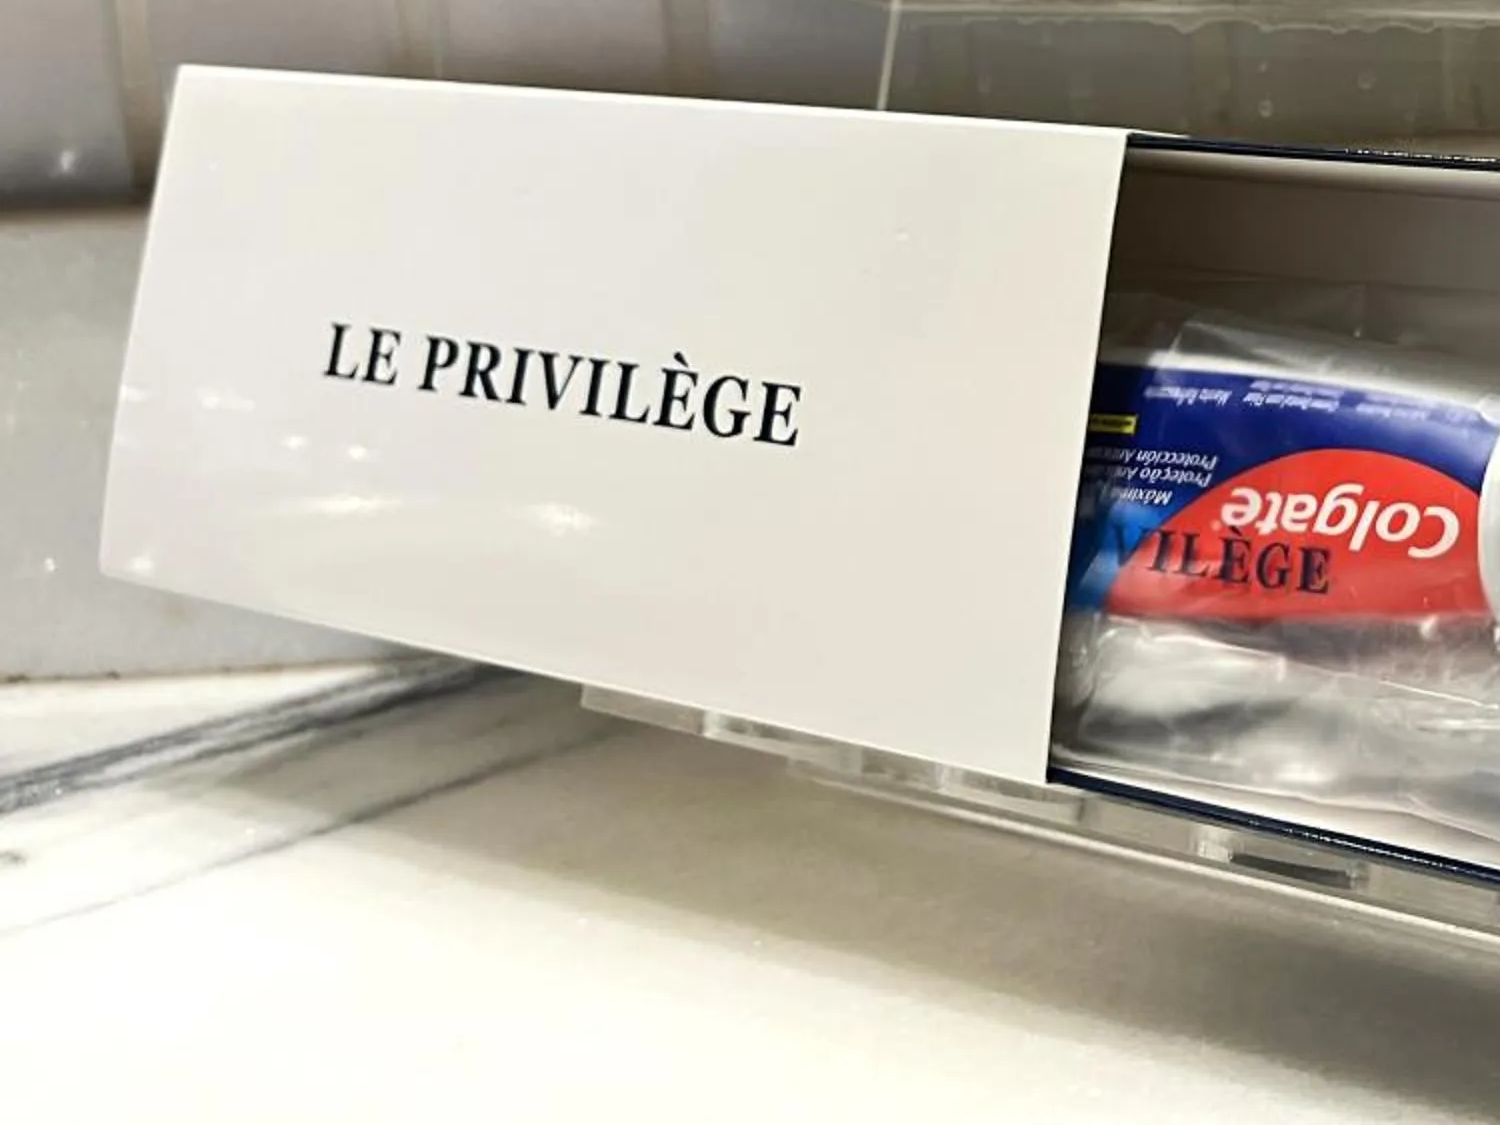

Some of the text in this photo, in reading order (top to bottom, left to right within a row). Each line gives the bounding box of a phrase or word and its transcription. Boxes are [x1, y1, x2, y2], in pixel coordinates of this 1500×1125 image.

[324, 321, 802, 447] LE PRIVILÈGE
[1139, 467, 1213, 488] Proteção
[1220, 483, 1460, 559] Colgate
